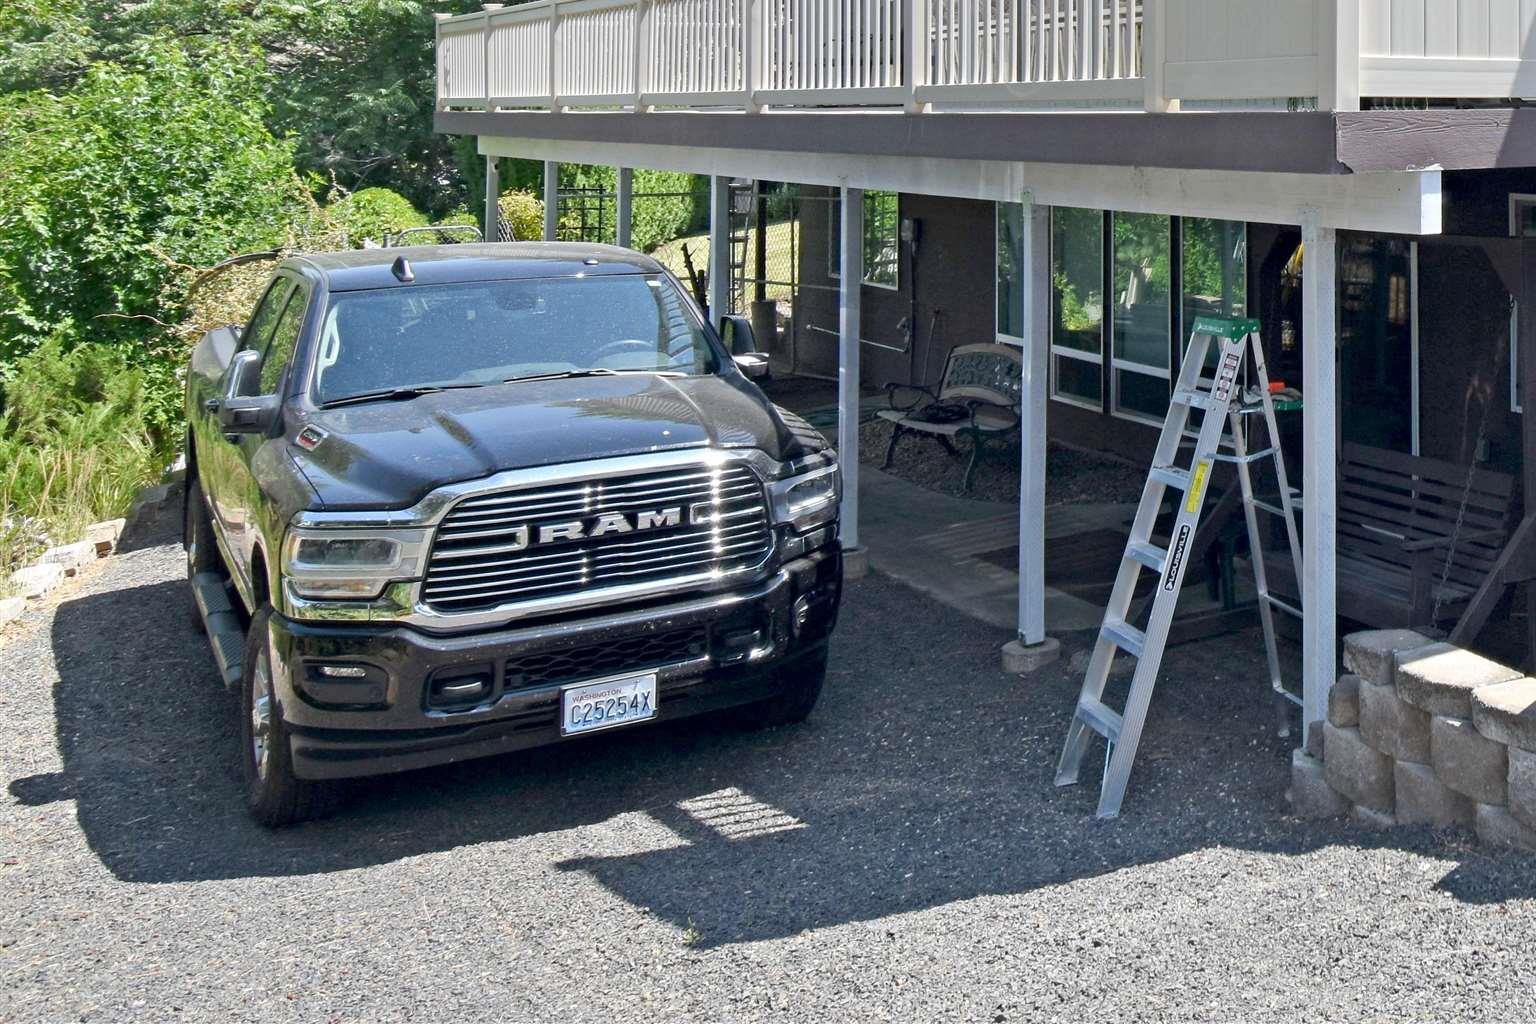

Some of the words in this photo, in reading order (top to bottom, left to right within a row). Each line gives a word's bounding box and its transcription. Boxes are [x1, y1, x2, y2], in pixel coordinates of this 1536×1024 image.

[539, 506, 682, 544] RAM
[1169, 525, 1189, 582] LOUISVILLE
[571, 688, 623, 703] WASHINGTON
[571, 690, 651, 725] C25254X
